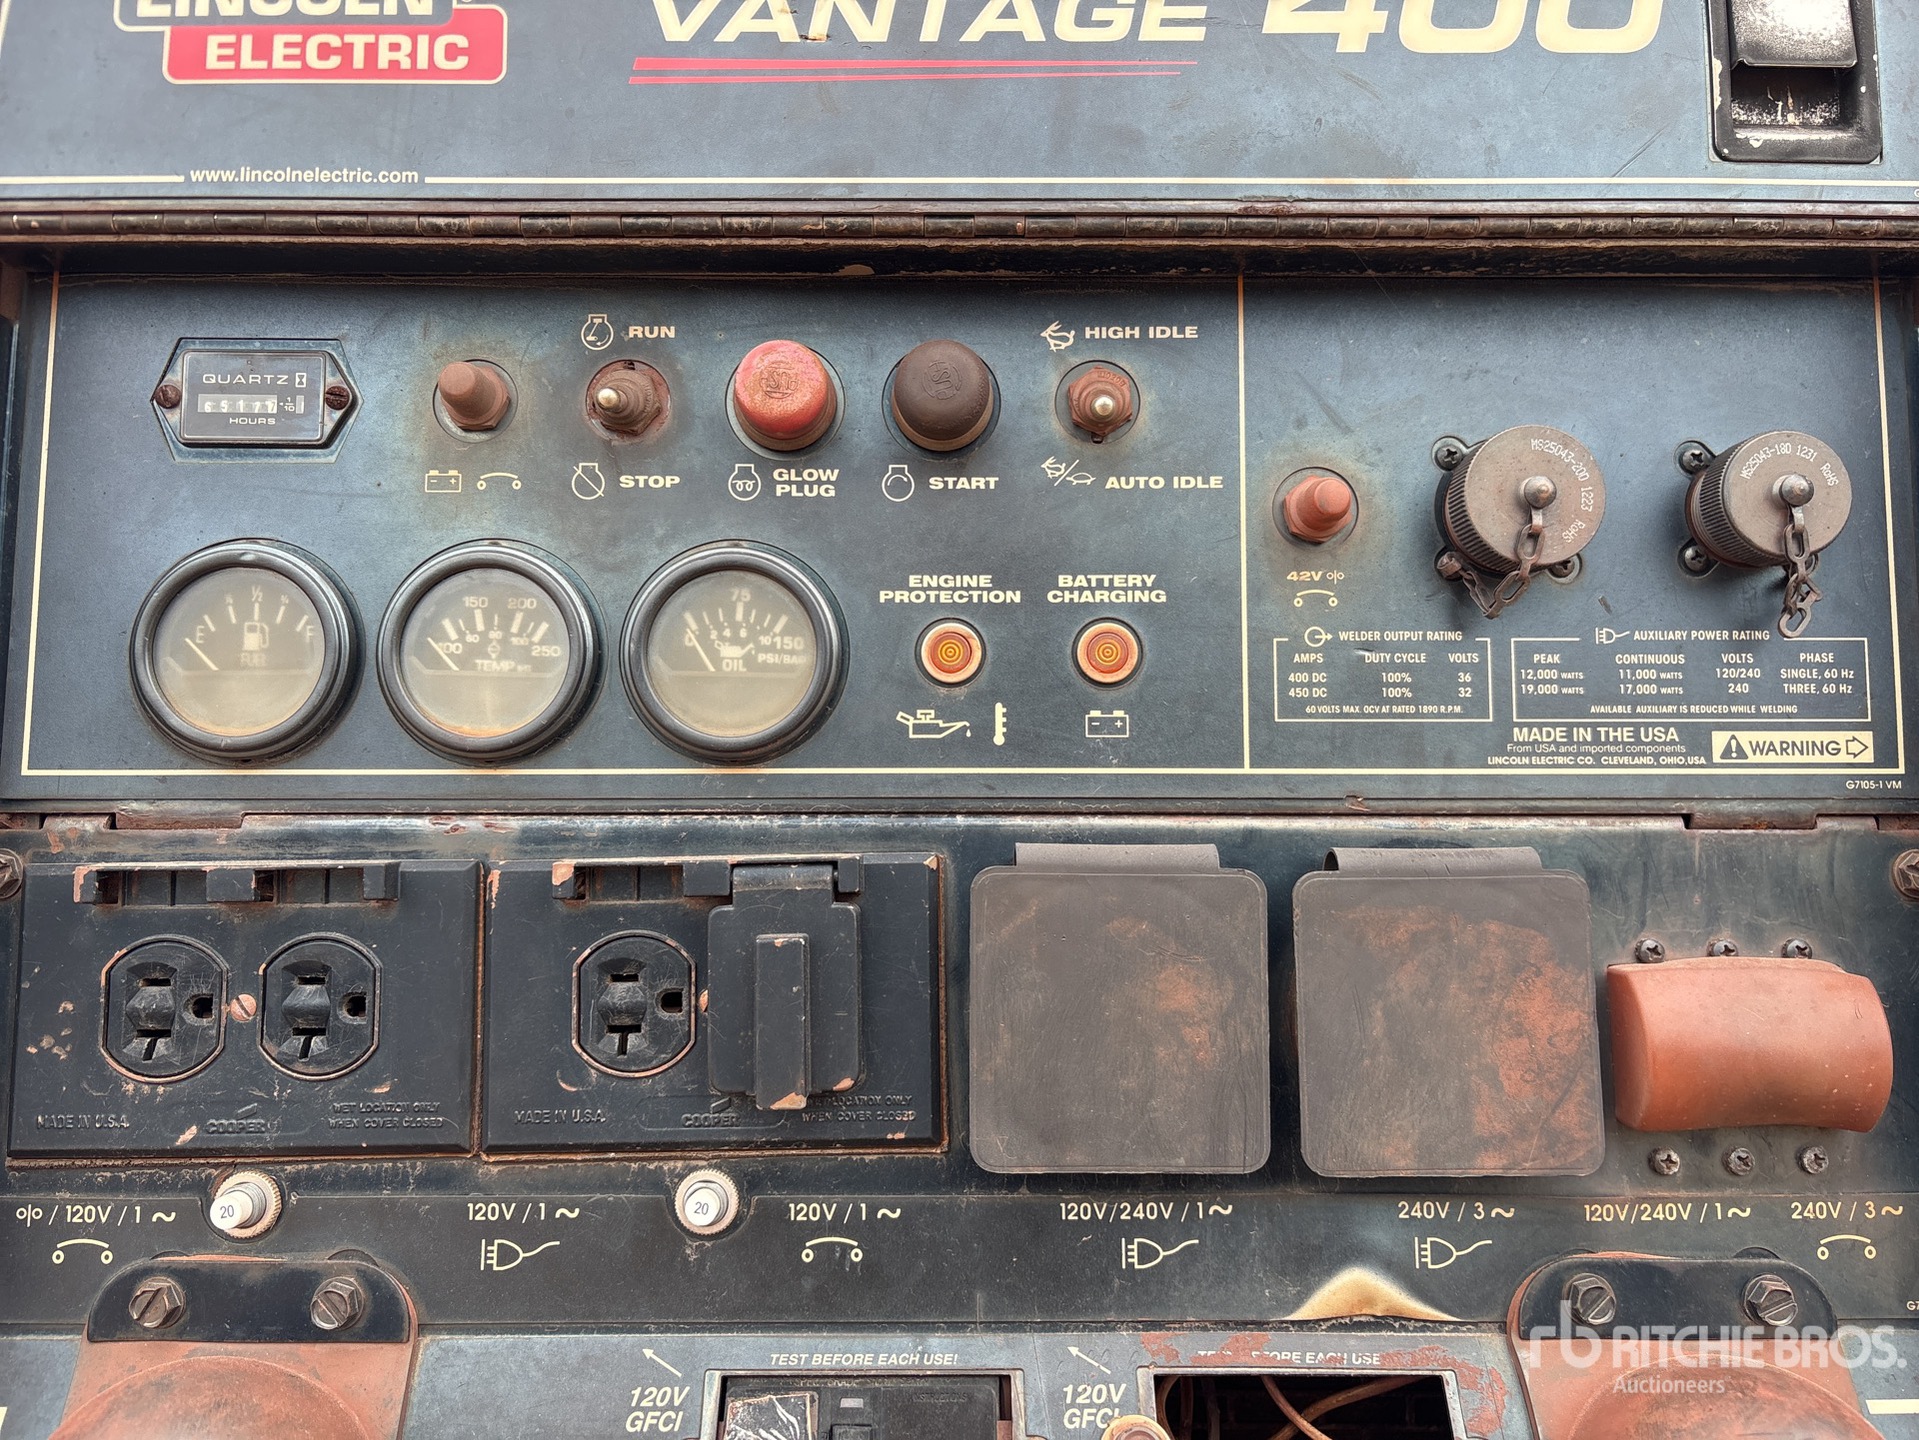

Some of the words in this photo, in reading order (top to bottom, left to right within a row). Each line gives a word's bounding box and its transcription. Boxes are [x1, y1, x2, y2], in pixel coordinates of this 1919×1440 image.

[652, 0, 1207, 42] VANTAGE
[1262, 0, 1663, 53] 400
[206, 34, 469, 70] ELECTRIC
[190, 167, 418, 185] www.lincolnelectric.com
[628, 326, 676, 338] RUN
[1085, 326, 1140, 339] HIGH
[1148, 326, 1198, 339] IDLE
[203, 374, 289, 385] QUARTZ
[229, 417, 276, 425] HOURS
[773, 469, 840, 482] GLOW
[1819, 462, 1839, 487] RoHS
[619, 475, 681, 489] STOP
[928, 477, 999, 490] START
[1105, 476, 1165, 489] AUTO
[1173, 476, 1223, 489] IDLE
[776, 484, 836, 498] PLUG
[1561, 519, 1586, 544] RoHS
[908, 575, 993, 588] ENGINE
[1058, 574, 1157, 588] BATTERY
[1286, 571, 1323, 582] 42V
[463, 596, 489, 609] 150
[879, 590, 1021, 604] PROTECTION
[1047, 590, 1167, 603] CHARGING
[507, 597, 537, 610] 200
[195, 625, 205, 644] E
[305, 625, 315, 643] F
[709, 629, 718, 639] 2
[723, 628, 731, 638] 4
[739, 628, 748, 638] 6
[1338, 631, 1381, 641] WELDER
[1384, 631, 1424, 641] OUTPUT
[1426, 631, 1463, 641] RATING
[1633, 630, 1688, 641] AUXILIARY
[1690, 630, 1728, 641] POWER
[1730, 630, 1770, 641] RATING
[758, 635, 772, 646] 10
[773, 635, 805, 650] 150
[531, 645, 562, 657] 250
[1800, 652, 1834, 663] PHASE
[1293, 653, 1324, 663] AMPS
[1364, 653, 1391, 663] DUTY
[1394, 653, 1427, 663] CYCLE
[1448, 653, 1479, 663] VOLTS
[1534, 654, 1561, 664] PEAK
[1615, 654, 1686, 664] CONTINUOUS
[1721, 653, 1754, 663] VOLTS
[475, 659, 516, 672] TEMP
[722, 659, 747, 672] OIL
[1288, 672, 1309, 682] 400
[1312, 672, 1327, 682] DC
[1381, 672, 1412, 682] 100%
[1458, 672, 1472, 682] 36
[1520, 670, 1558, 681] 12,000
[1560, 670, 1584, 681] WATTS
[1618, 669, 1656, 680] 11,000
[1660, 669, 1683, 680] WATTS
[1715, 668, 1761, 680] 120/240
[1780, 668, 1822, 680] SINGLE,
[1824, 668, 1840, 680] 60
[1842, 668, 1854, 680] Hz
[1288, 688, 1309, 698] 450
[1312, 688, 1327, 698] DC
[1381, 688, 1412, 698] 100%
[1458, 688, 1472, 698] 32
[1521, 685, 1558, 696] 19,000
[1561, 685, 1584, 696] WATTS
[1620, 685, 1657, 696] 17,000
[1660, 685, 1683, 696] WATTS
[1728, 684, 1750, 694] 240
[1783, 684, 1820, 696] THREE,
[1822, 684, 1838, 696] 60
[1839, 684, 1853, 696] Hz
[1305, 705, 1316, 714] 60
[1316, 705, 1340, 714] VOLTS
[1342, 705, 1362, 714] MAX.
[1363, 705, 1380, 714] OCV
[1381, 705, 1390, 714] AT
[1392, 705, 1416, 714] RATED
[1418, 705, 1438, 714] 1890
[1440, 705, 1464, 714] R.P.M.
[1590, 705, 1632, 714] AVAILABLE
[1636, 705, 1677, 714] AUXILIARY
[1679, 705, 1688, 714] IS
[1690, 705, 1728, 714] REDUCED
[1729, 705, 1756, 714] WHILE
[1760, 705, 1798, 714] WELDING
[1513, 727, 1567, 742] MADE
[1573, 727, 1592, 742] IN
[1597, 727, 1634, 742] THE
[1640, 727, 1680, 742] USA
[1507, 743, 1532, 755] From
[1534, 743, 1557, 755] USA
[1559, 743, 1577, 755] and
[1580, 743, 1623, 755] imported
[1625, 743, 1686, 755] components
[1749, 740, 1841, 756] WARNING
[1488, 756, 1530, 766] LINCOLN
[1532, 756, 1575, 766] ELECTRIC
[1577, 756, 1596, 766] CO.
[1600, 756, 1657, 766] CLEVELAND,
[1885, 780, 1902, 790] VM
[885, 1095, 913, 1106] ONLY
[332, 1102, 356, 1114] WET
[359, 1102, 410, 1114] LOCATION
[413, 1102, 441, 1114] ONLY
[36, 1115, 76, 1130] MADE
[77, 1115, 92, 1130] IN
[514, 1109, 552, 1125] MADE
[554, 1109, 569, 1125] IN
[682, 1113, 739, 1128] COOPER
[802, 1110, 833, 1122] WHEN
[837, 1110, 873, 1122] COVER
[206, 1119, 266, 1135] COOPER
[328, 1117, 360, 1130] WHEN
[364, 1117, 399, 1130] COVER
[402, 1117, 444, 1130] CLOSED
[66, 1206, 111, 1223] 120V
[219, 1205, 235, 1220] 20
[467, 1203, 515, 1221] 120V
[694, 1201, 710, 1216] 20
[789, 1203, 837, 1221] 120V
[1060, 1202, 1173, 1223] 120V/240V
[1398, 1201, 1449, 1221] 240V
[1584, 1203, 1692, 1225] 120V/240V
[1791, 1201, 1842, 1221] 240V
[770, 1353, 808, 1366] TEST
[813, 1353, 872, 1366] BEFORE
[876, 1353, 919, 1366] EACH
[923, 1353, 958, 1366] USE!
[630, 1386, 690, 1406] 120V
[1063, 1383, 1127, 1404] 120V
[625, 1411, 683, 1433] GFCI
